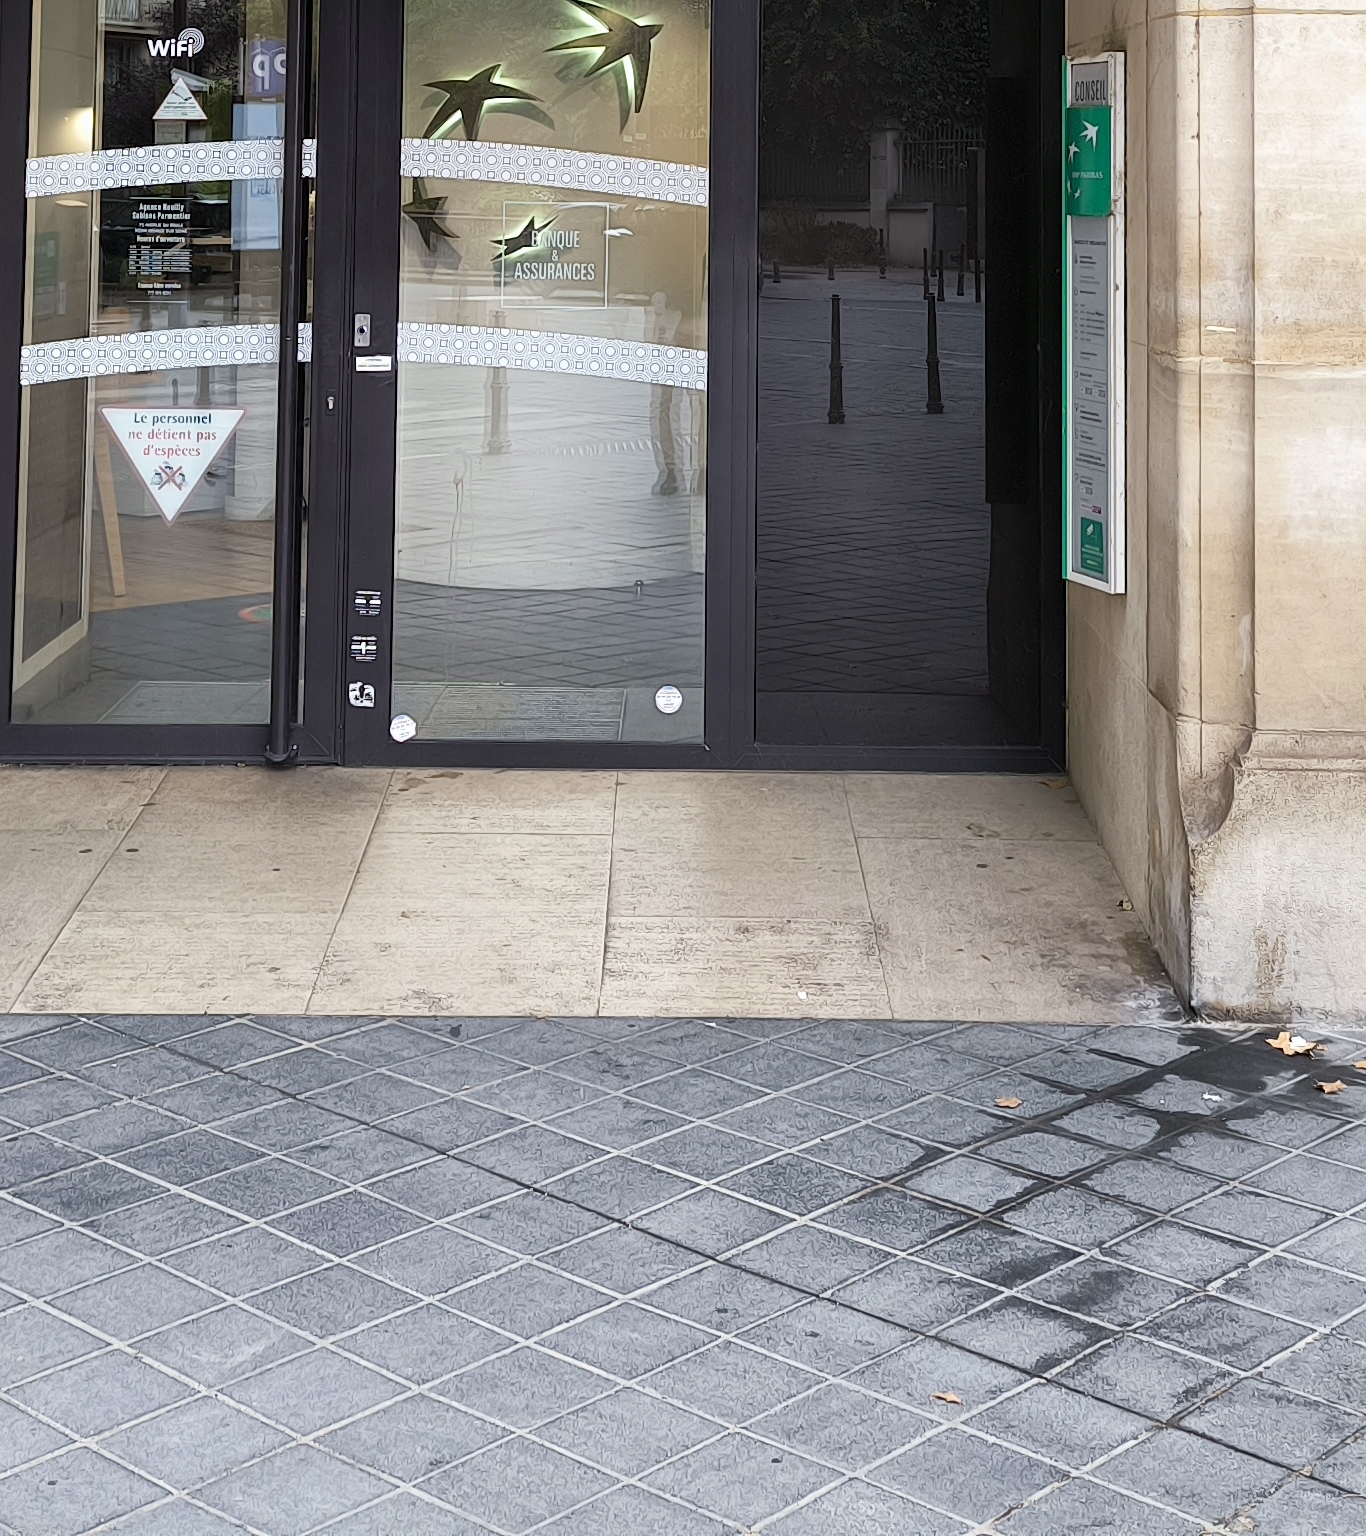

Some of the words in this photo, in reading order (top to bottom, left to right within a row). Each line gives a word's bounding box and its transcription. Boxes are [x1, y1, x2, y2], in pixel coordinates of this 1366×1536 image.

[147, 38, 194, 58] WiFi
[1074, 78, 1106, 102] CONSEIL
[531, 230, 580, 250] BANQUE
[551, 250, 559, 261] &
[514, 262, 595, 281] ASSURANCES
[134, 412, 147, 423] Le
[152, 412, 212, 426] personnel
[128, 430, 143, 440] ne
[147, 428, 191, 440] détient
[196, 430, 217, 443] pas
[143, 444, 201, 459] d'espèces
